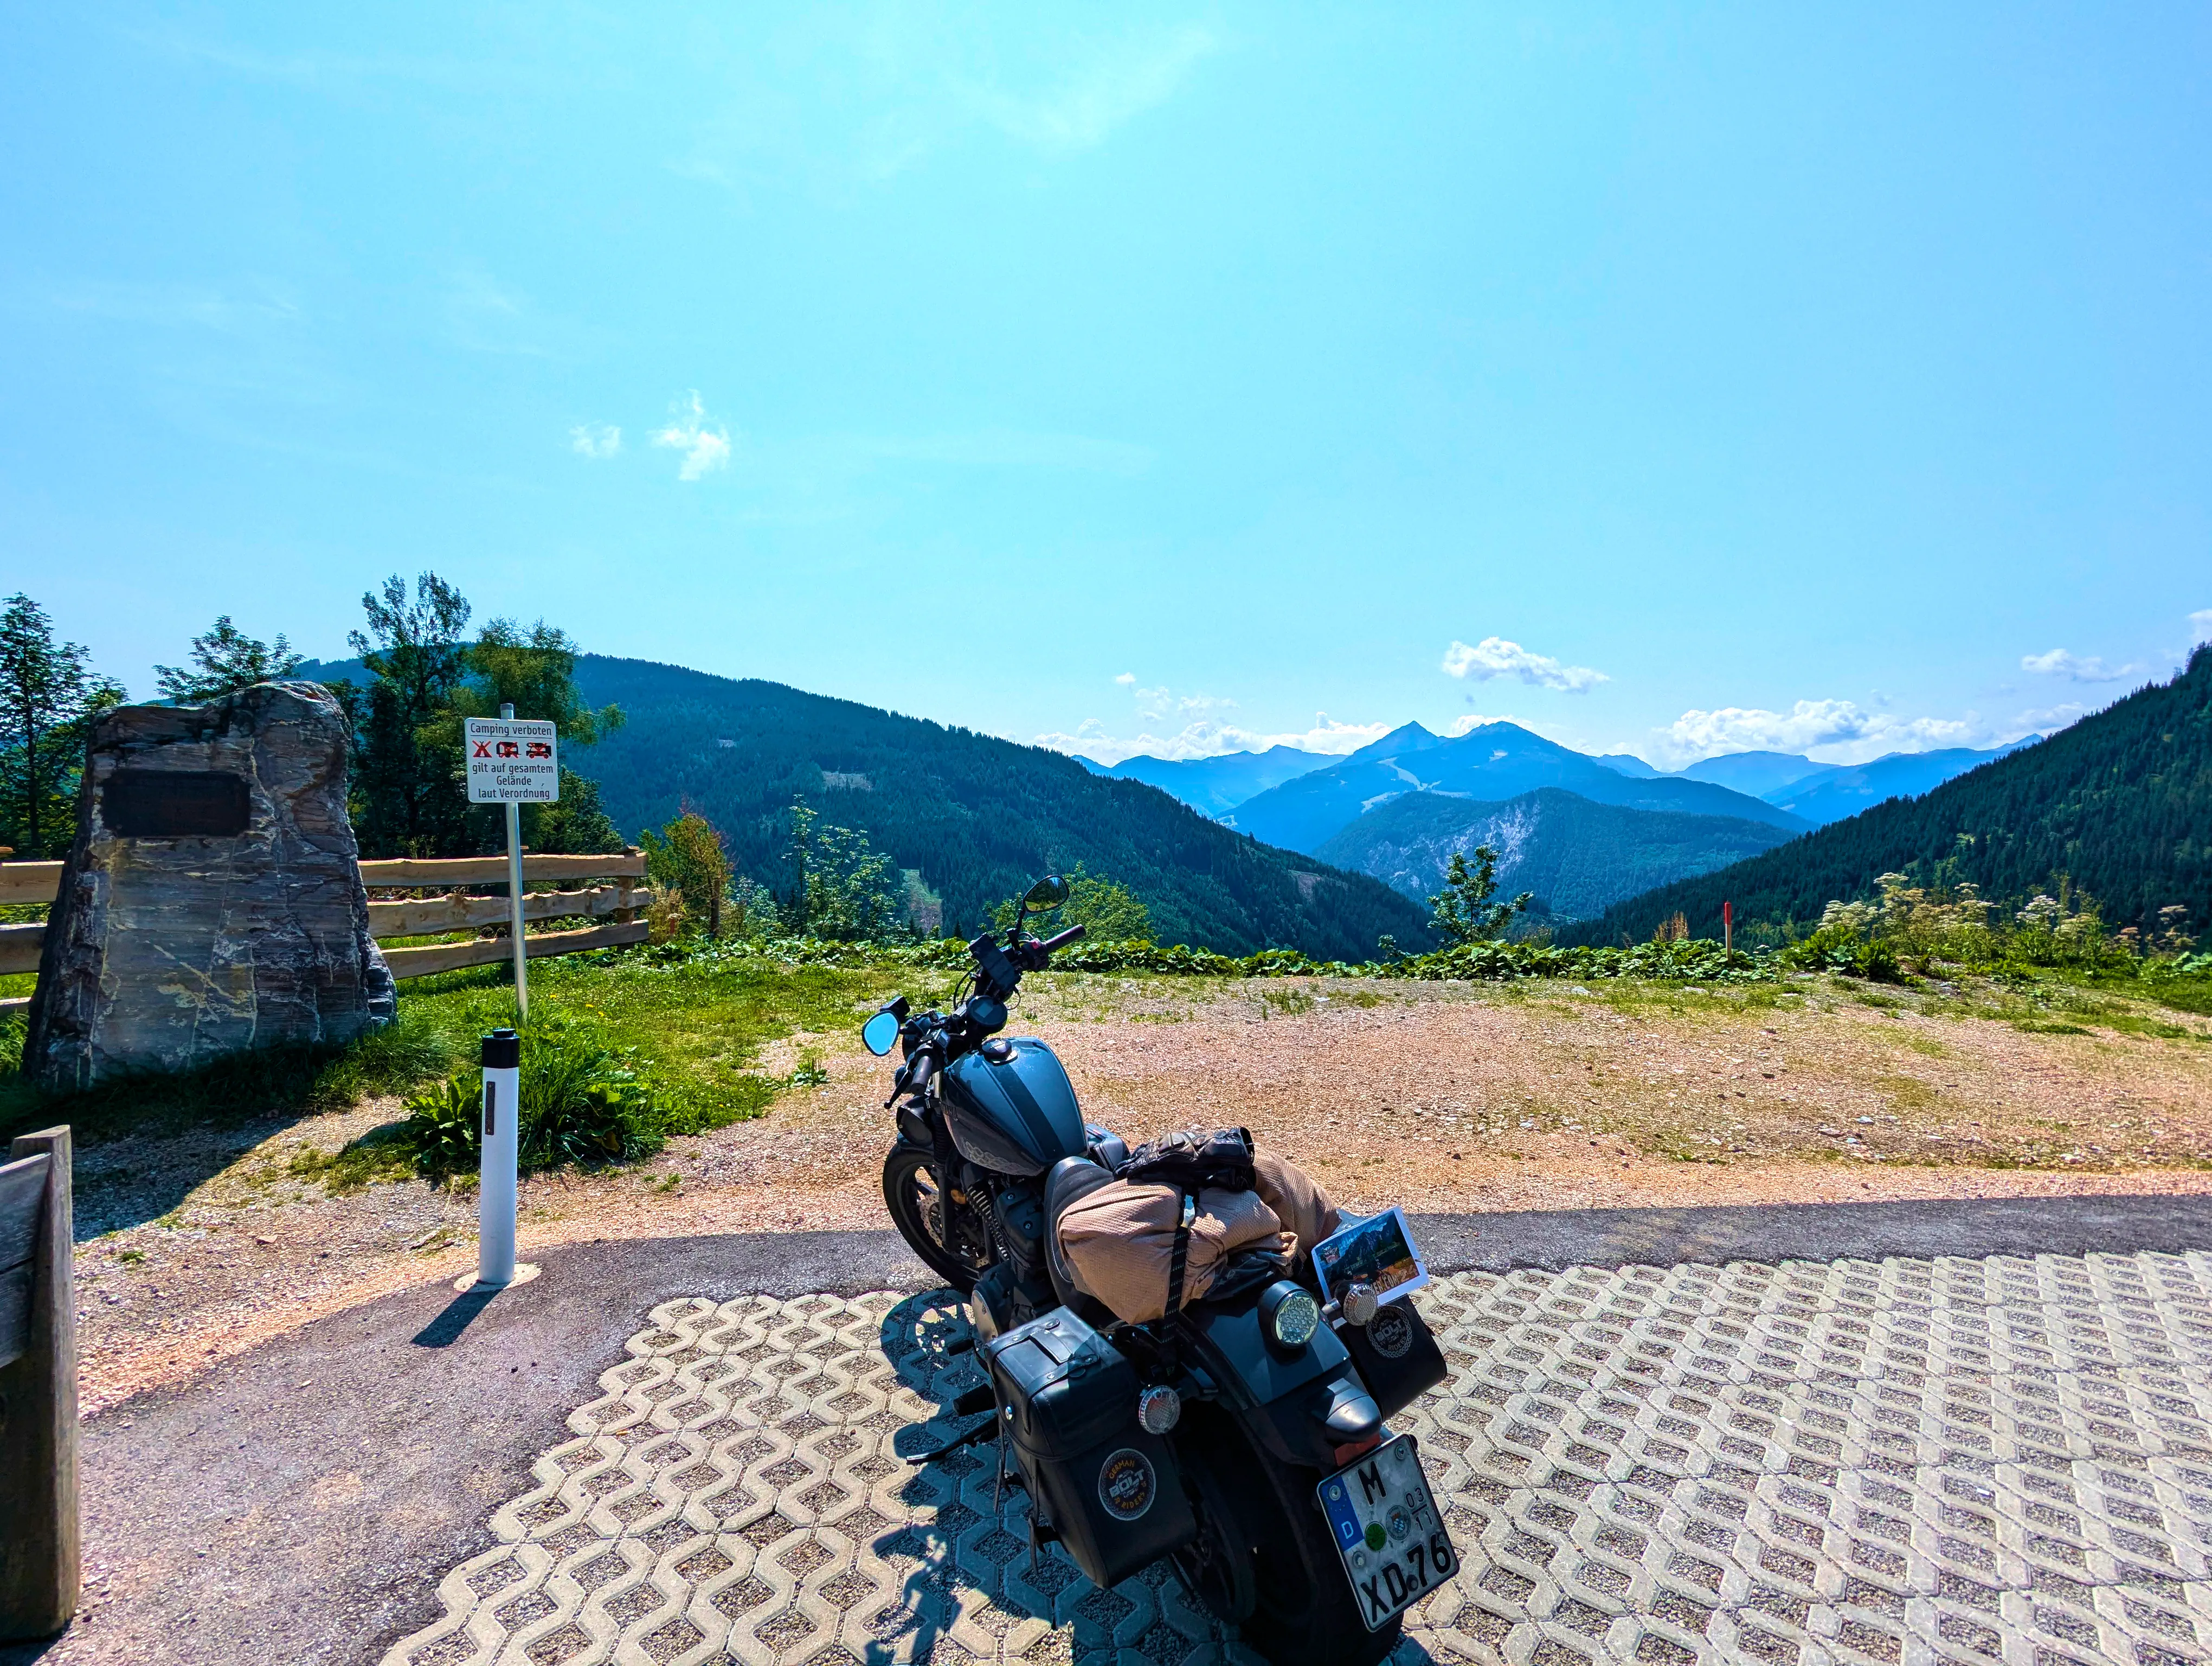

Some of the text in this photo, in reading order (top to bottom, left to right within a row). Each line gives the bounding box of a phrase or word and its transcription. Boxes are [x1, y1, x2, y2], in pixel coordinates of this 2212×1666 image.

[471, 723, 552, 736] Camping verboten
[472, 762, 554, 774] gilt auf gesamtem
[497, 776, 532, 785] Gelände
[478, 789, 550, 800] laut Verordnung
[1372, 1310, 1394, 1329] GERMAN
[1374, 1319, 1401, 1342] BOLT
[1388, 1334, 1406, 1351] RIDERS
[1109, 1459, 1135, 1479] GERMAN
[1108, 1469, 1144, 1498] BOLT
[1357, 1461, 1386, 1505] M
[1121, 1492, 1145, 1509] RIDERS
[1405, 1487, 1424, 1508] 03
[1341, 1521, 1354, 1539] D
[1415, 1510, 1432, 1531] 11
[1360, 1535, 1451, 1623] XD 76
